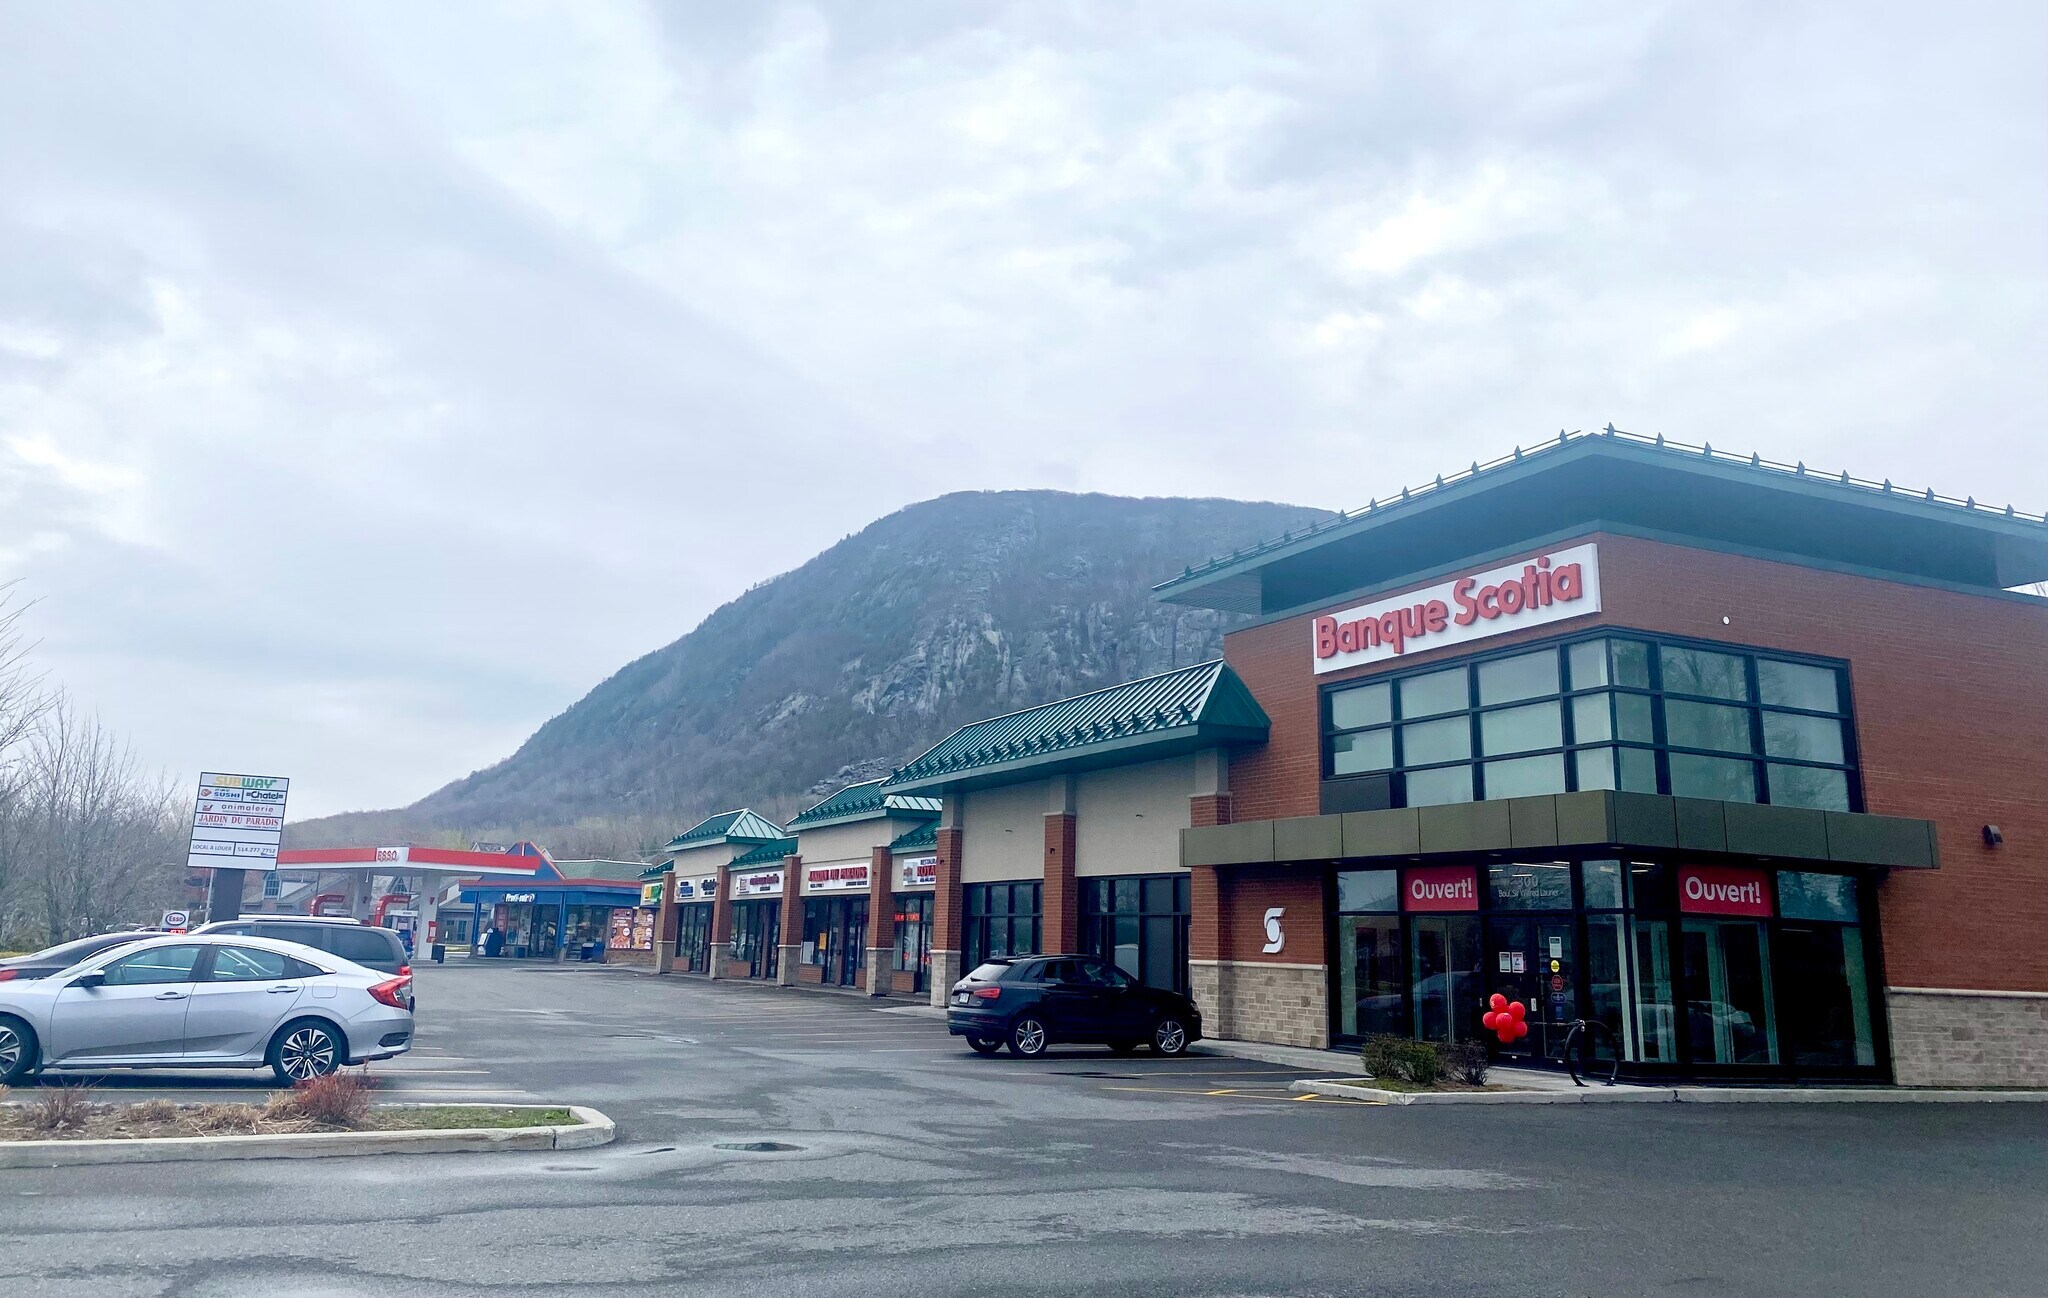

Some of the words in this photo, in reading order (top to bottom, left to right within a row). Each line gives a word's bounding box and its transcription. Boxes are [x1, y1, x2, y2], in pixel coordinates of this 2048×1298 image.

[317, 600, 448, 660] Banque
[454, 555, 583, 626] Scotia
[214, 775, 277, 789] SUBWAY
[221, 803, 274, 813] animalerie
[199, 814, 227, 823] JARDIN
[231, 816, 242, 824] DU
[245, 817, 279, 827] PARADIS
[1411, 878, 1473, 900] Ouvert!
[1685, 876, 1761, 904] Ouvert!
